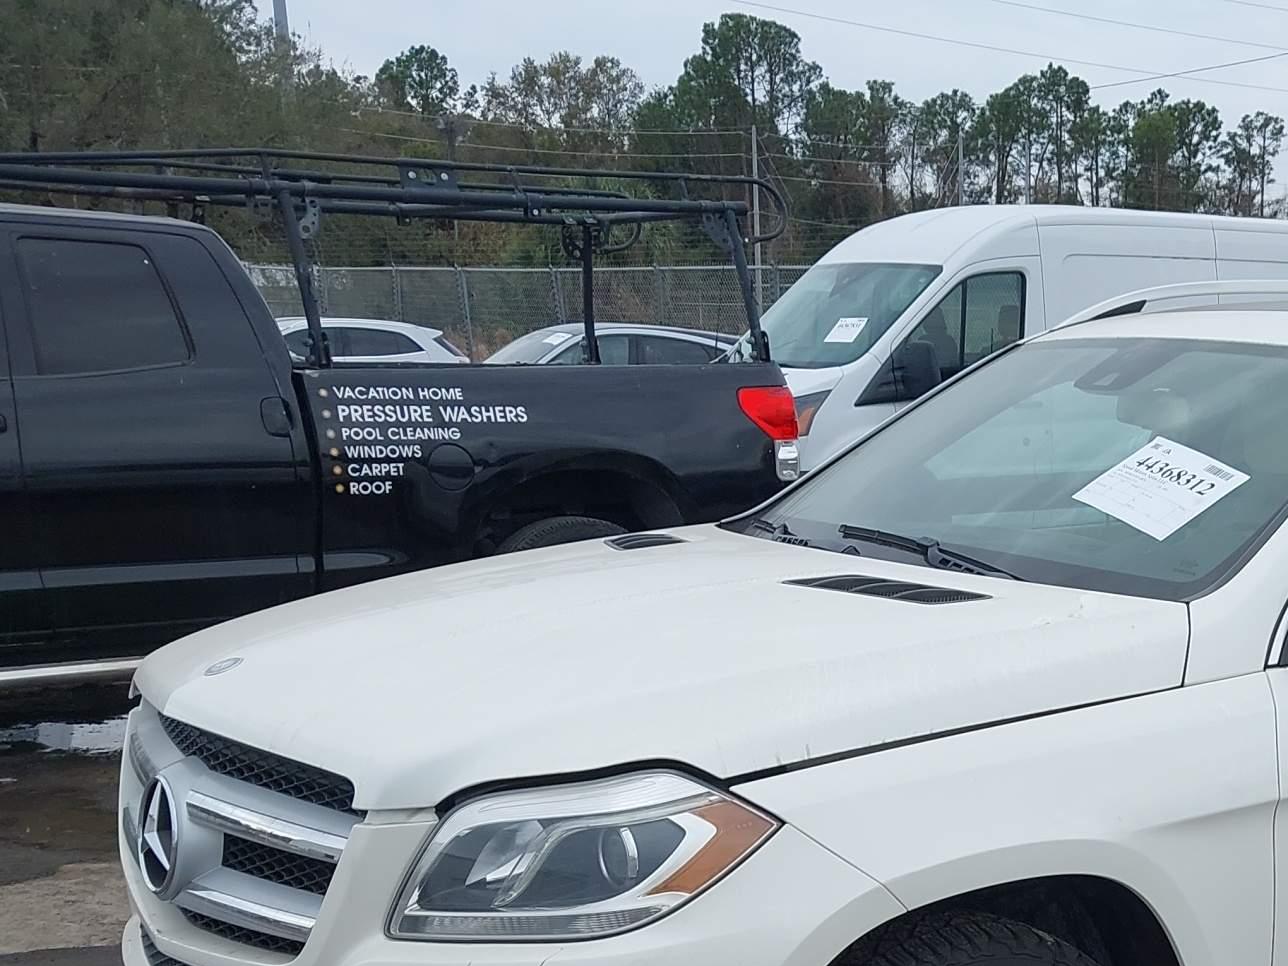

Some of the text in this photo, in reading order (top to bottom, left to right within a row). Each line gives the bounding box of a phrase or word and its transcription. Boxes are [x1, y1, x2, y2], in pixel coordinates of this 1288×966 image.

[332, 386, 463, 400] VACATION HOME
[337, 405, 528, 423] PRESSURE WASHERS
[341, 427, 461, 441] POOL CLEANING
[344, 445, 422, 459] WINDOWS
[347, 463, 405, 477] CARPET
[1136, 456, 1216, 496] 44368312
[349, 481, 393, 495] ROOF
